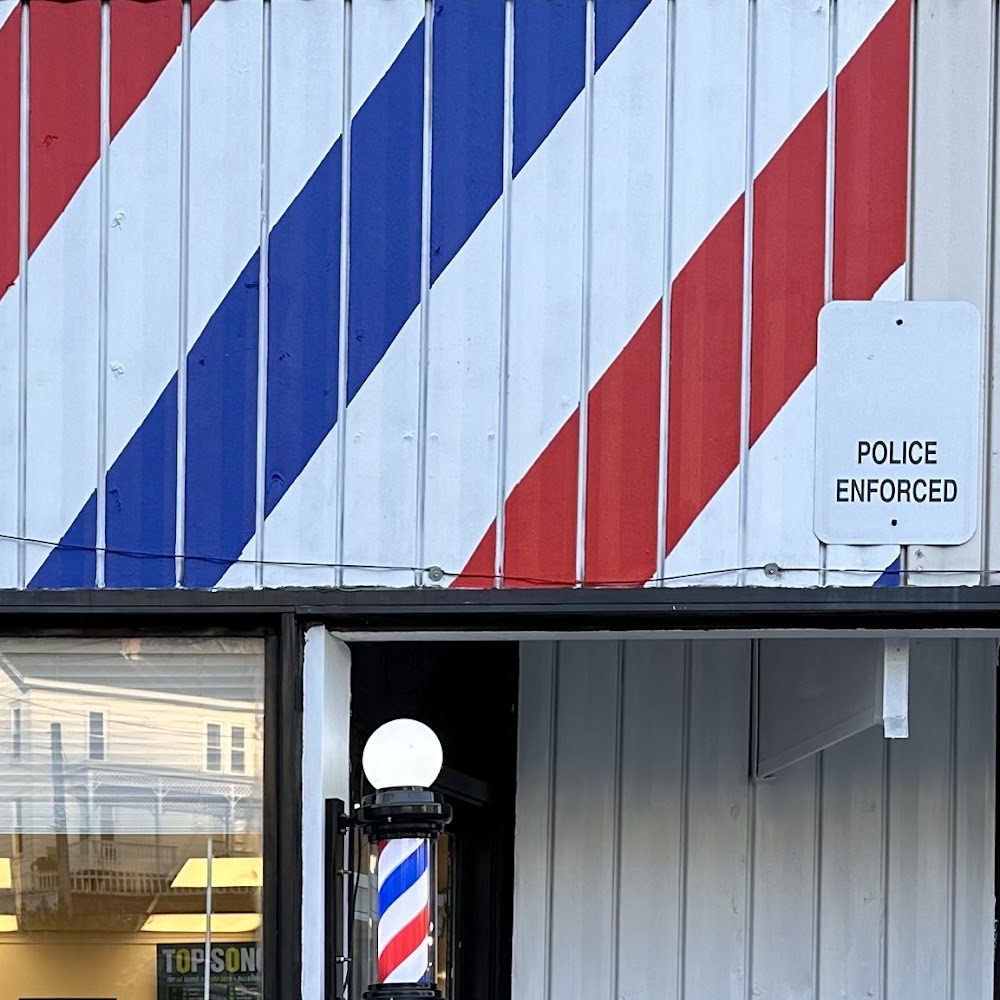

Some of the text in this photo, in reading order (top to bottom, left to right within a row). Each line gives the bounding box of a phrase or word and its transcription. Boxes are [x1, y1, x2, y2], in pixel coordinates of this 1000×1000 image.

[857, 440, 938, 465] POLICE
[836, 478, 958, 503] ENFORCED
[161, 948, 205, 974] TOP
